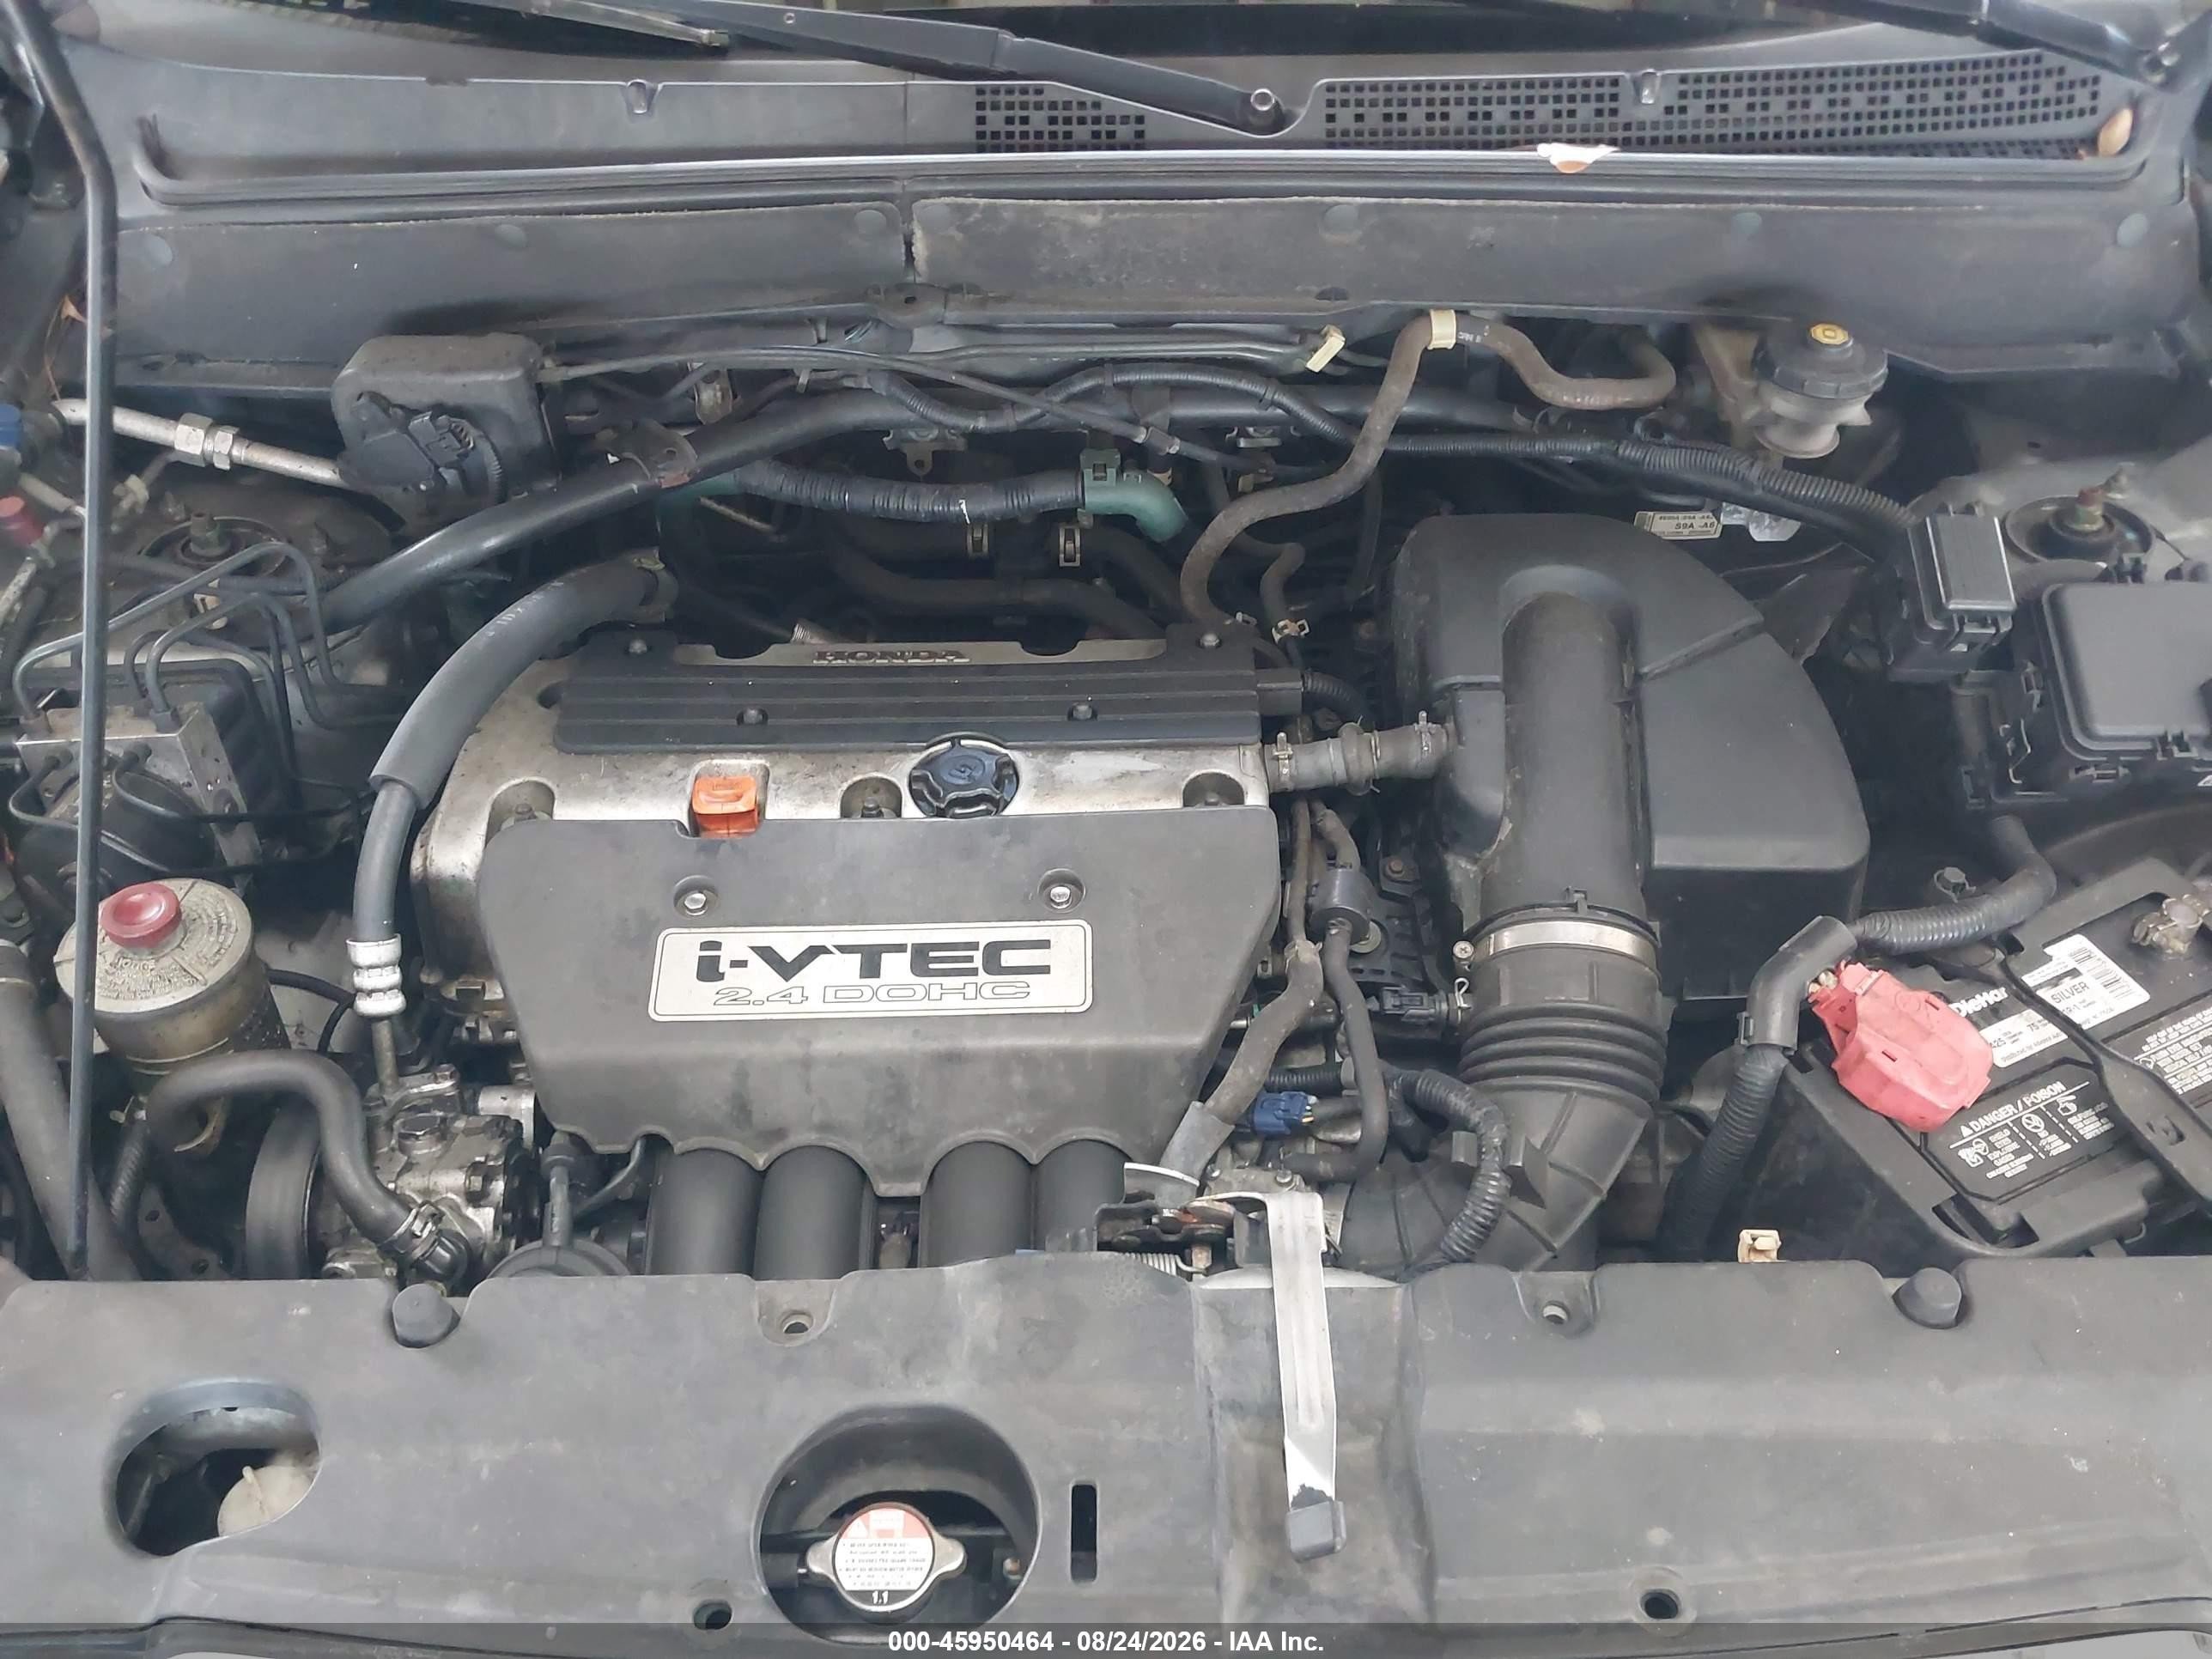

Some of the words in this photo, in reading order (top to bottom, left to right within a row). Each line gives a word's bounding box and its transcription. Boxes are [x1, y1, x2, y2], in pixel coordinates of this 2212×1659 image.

[812, 650, 970, 664] HONDA
[696, 939, 1051, 982] i-VTEC
[714, 985, 809, 1006] 2.4
[822, 981, 1031, 1004] DOHC
[2050, 981, 2090, 1005] SILVER
[1969, 1103, 2020, 1133] DANGER
[2022, 1081, 2067, 1107] POISON
